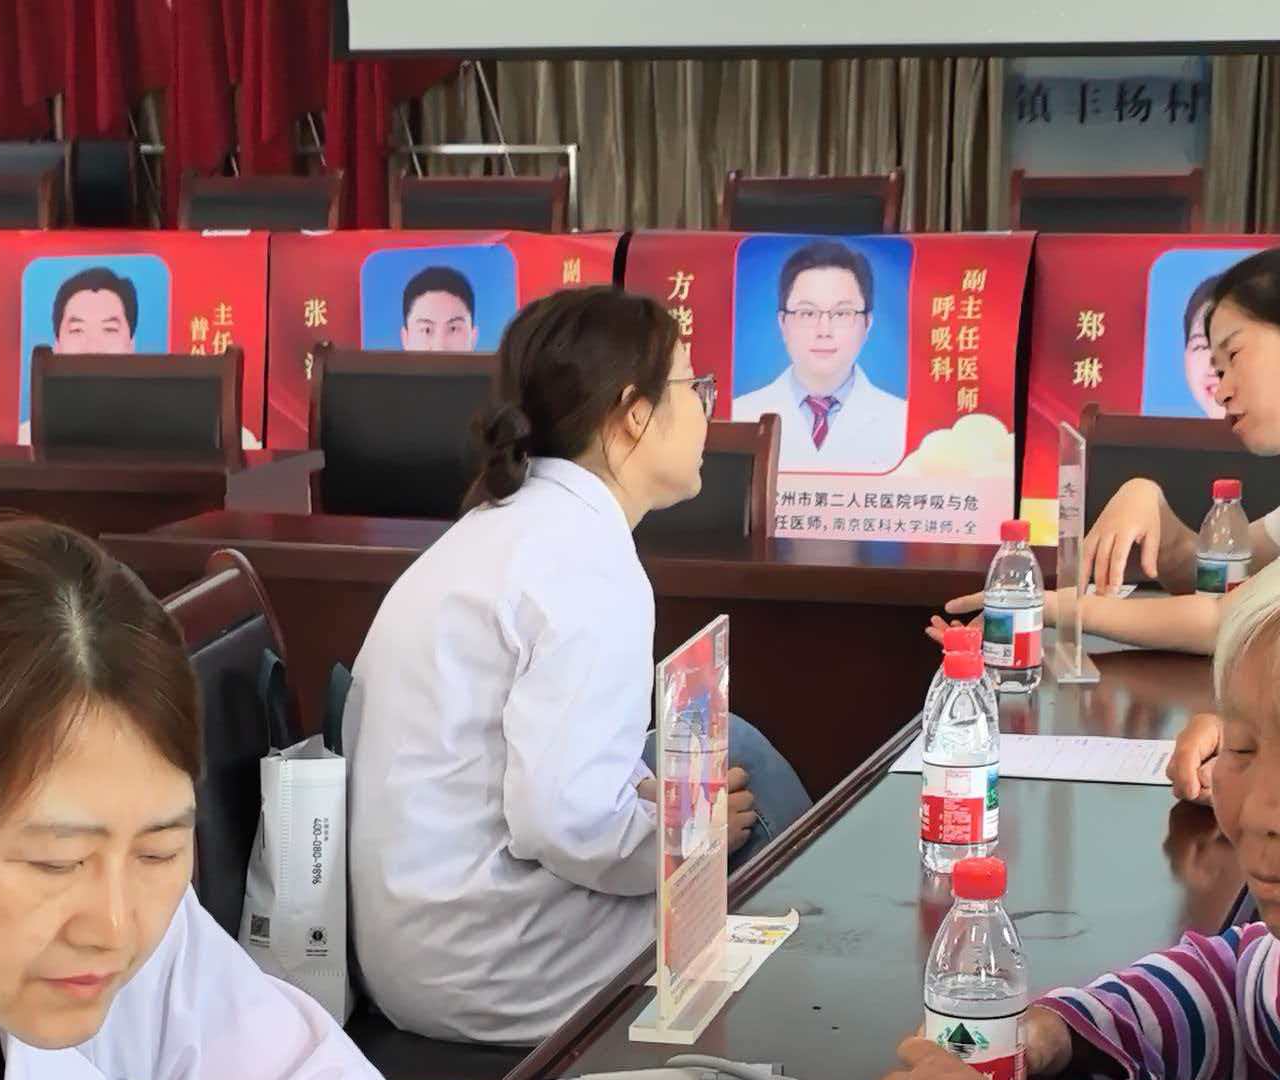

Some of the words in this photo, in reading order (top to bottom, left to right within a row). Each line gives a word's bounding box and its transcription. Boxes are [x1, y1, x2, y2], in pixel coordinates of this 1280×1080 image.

[668, 270, 695, 343] 方晓
[930, 294, 956, 383] 呼吸科
[957, 268, 988, 413] 副主任医师
[1072, 309, 1106, 389] 郑琳
[776, 490, 979, 512] 州市第二人民医院呼吸与危
